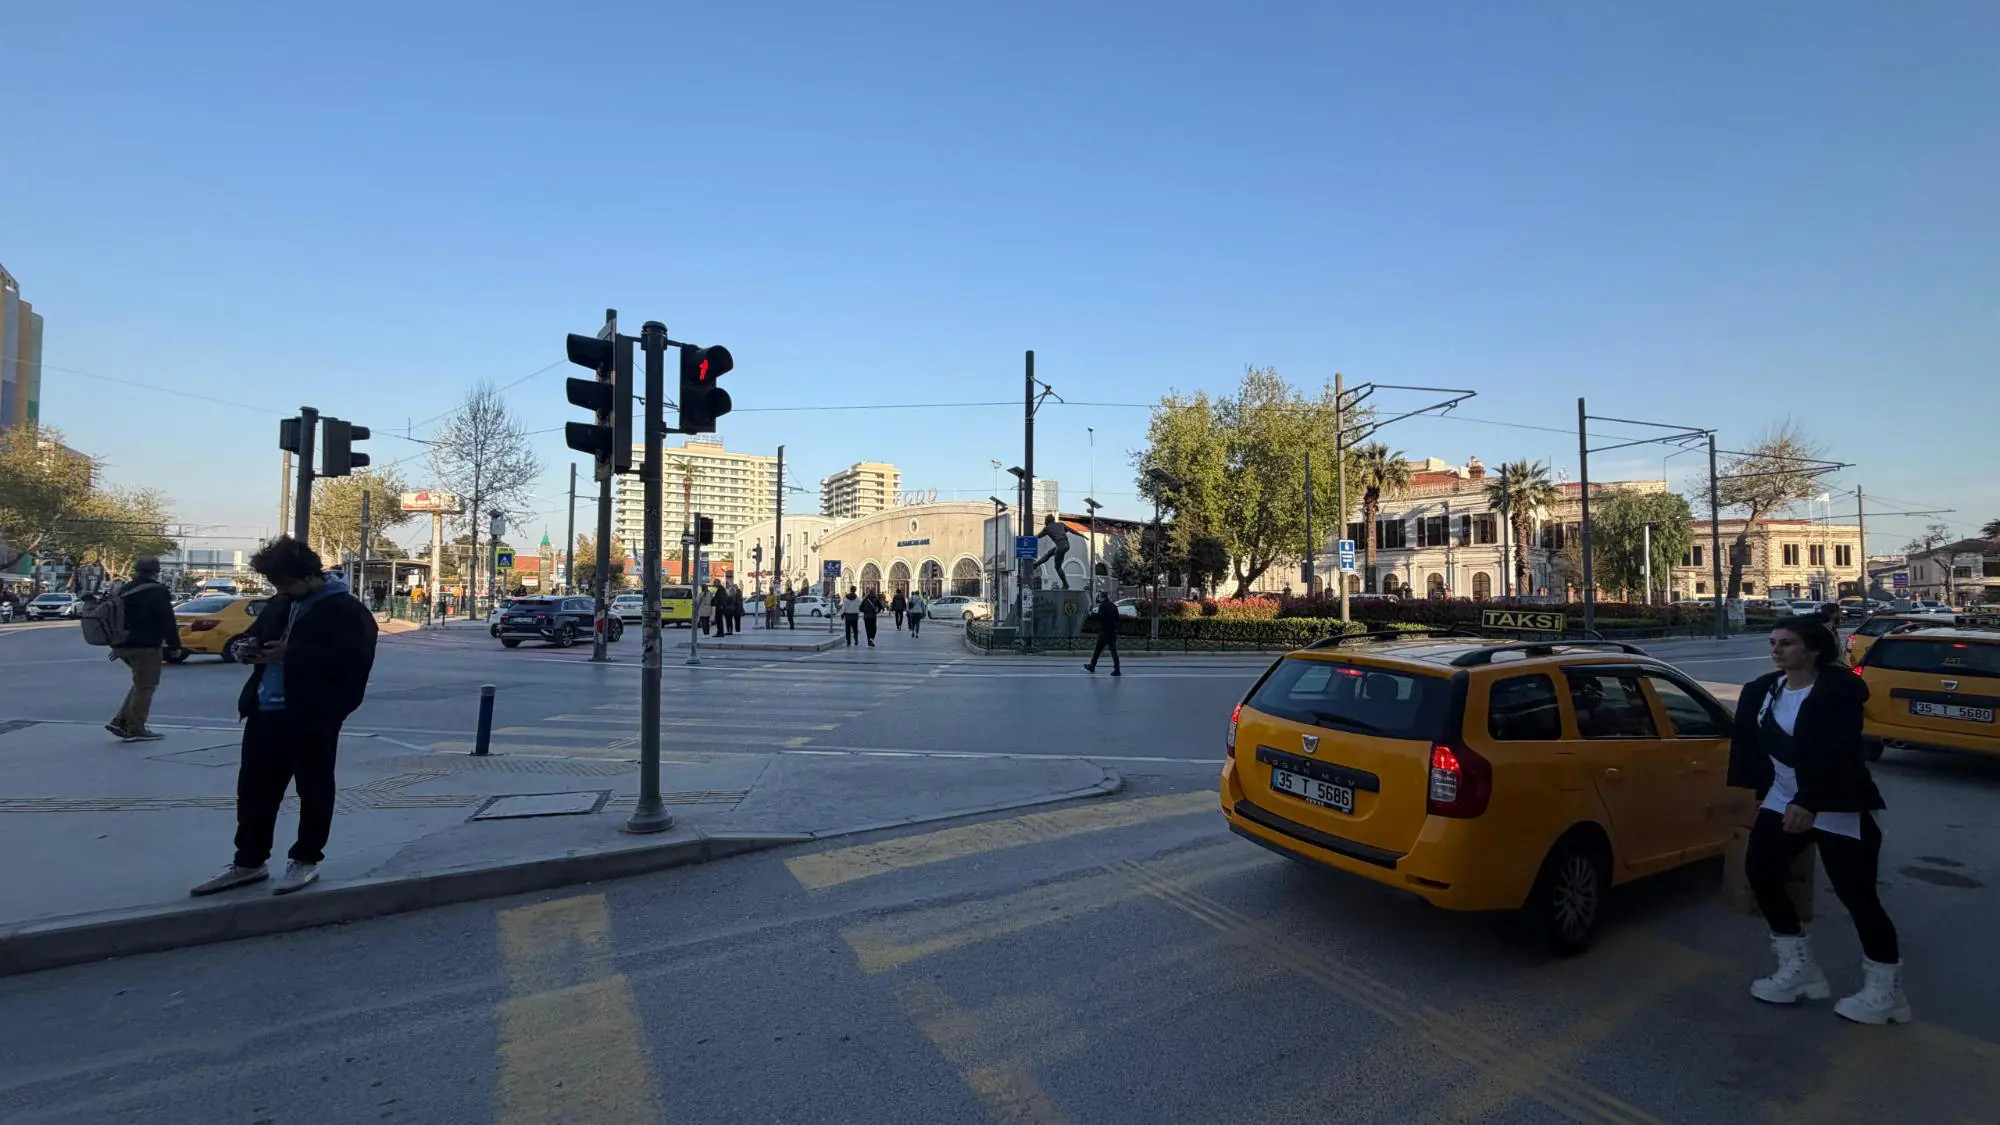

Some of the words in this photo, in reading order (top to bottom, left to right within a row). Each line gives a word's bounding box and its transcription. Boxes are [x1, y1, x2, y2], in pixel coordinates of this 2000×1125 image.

[1918, 703, 1932, 714] 35
[1942, 705, 1950, 714] T
[1960, 706, 1991, 720] 5680
[1278, 771, 1292, 789] 35
[1302, 778, 1310, 794] T
[1317, 782, 1349, 806] 5686
